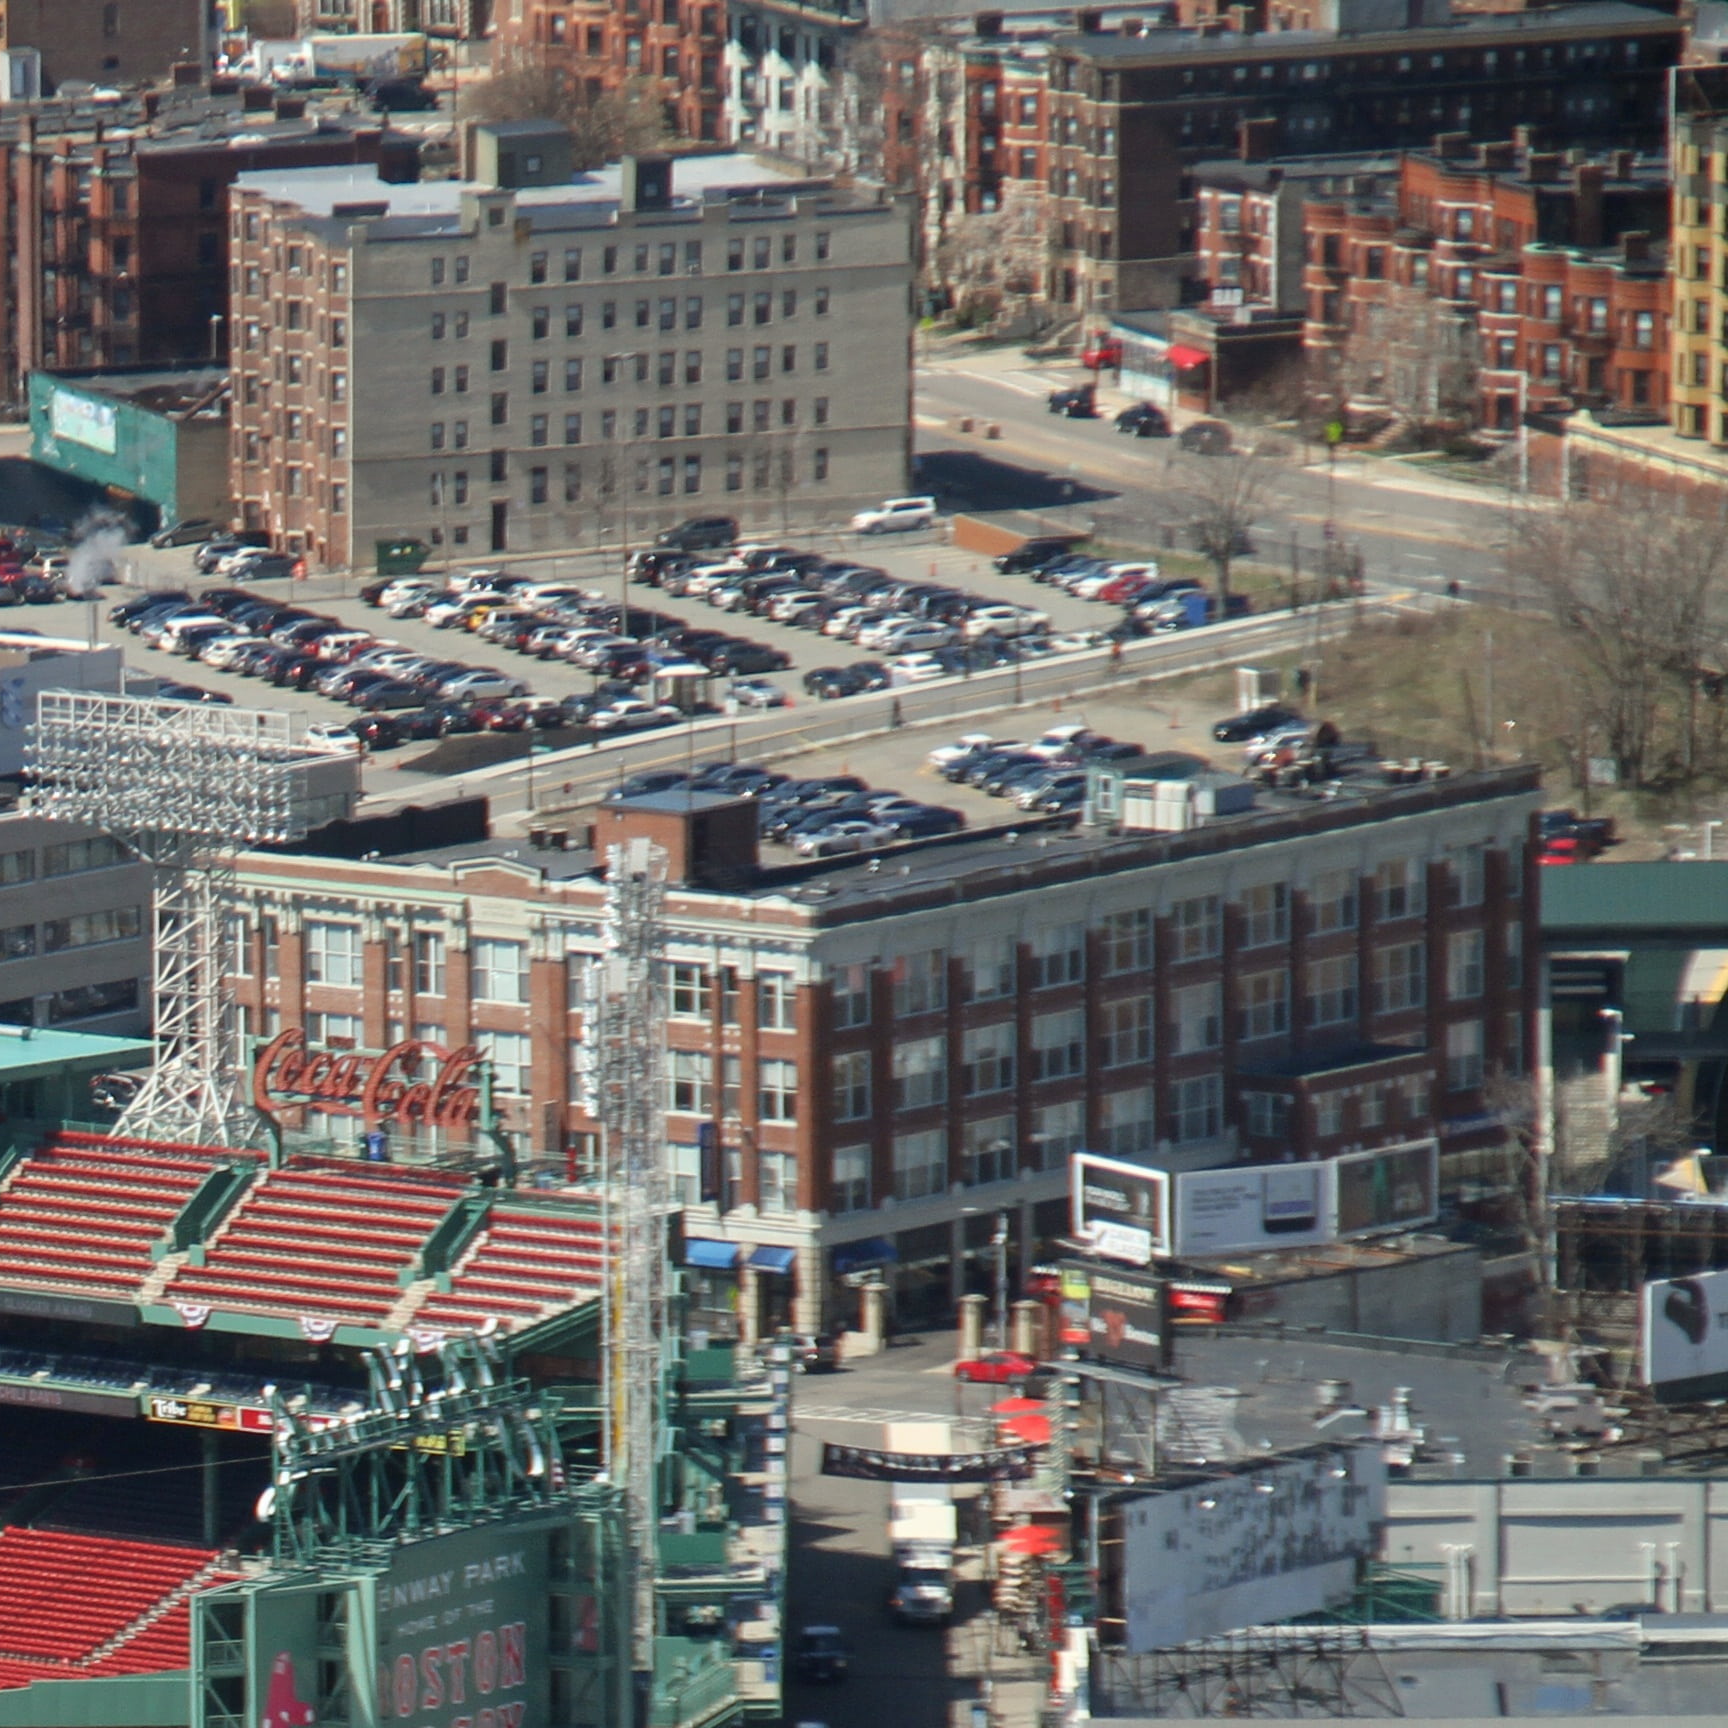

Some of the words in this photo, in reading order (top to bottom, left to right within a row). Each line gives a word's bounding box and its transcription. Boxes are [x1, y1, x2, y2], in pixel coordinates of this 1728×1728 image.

[253, 1027, 492, 1127] Coca-Cola
[152, 1399, 187, 1418] Tribe
[378, 1570, 455, 1612] ENWAY
[463, 1551, 527, 1588] PARK
[466, 1599, 494, 1617] THE
